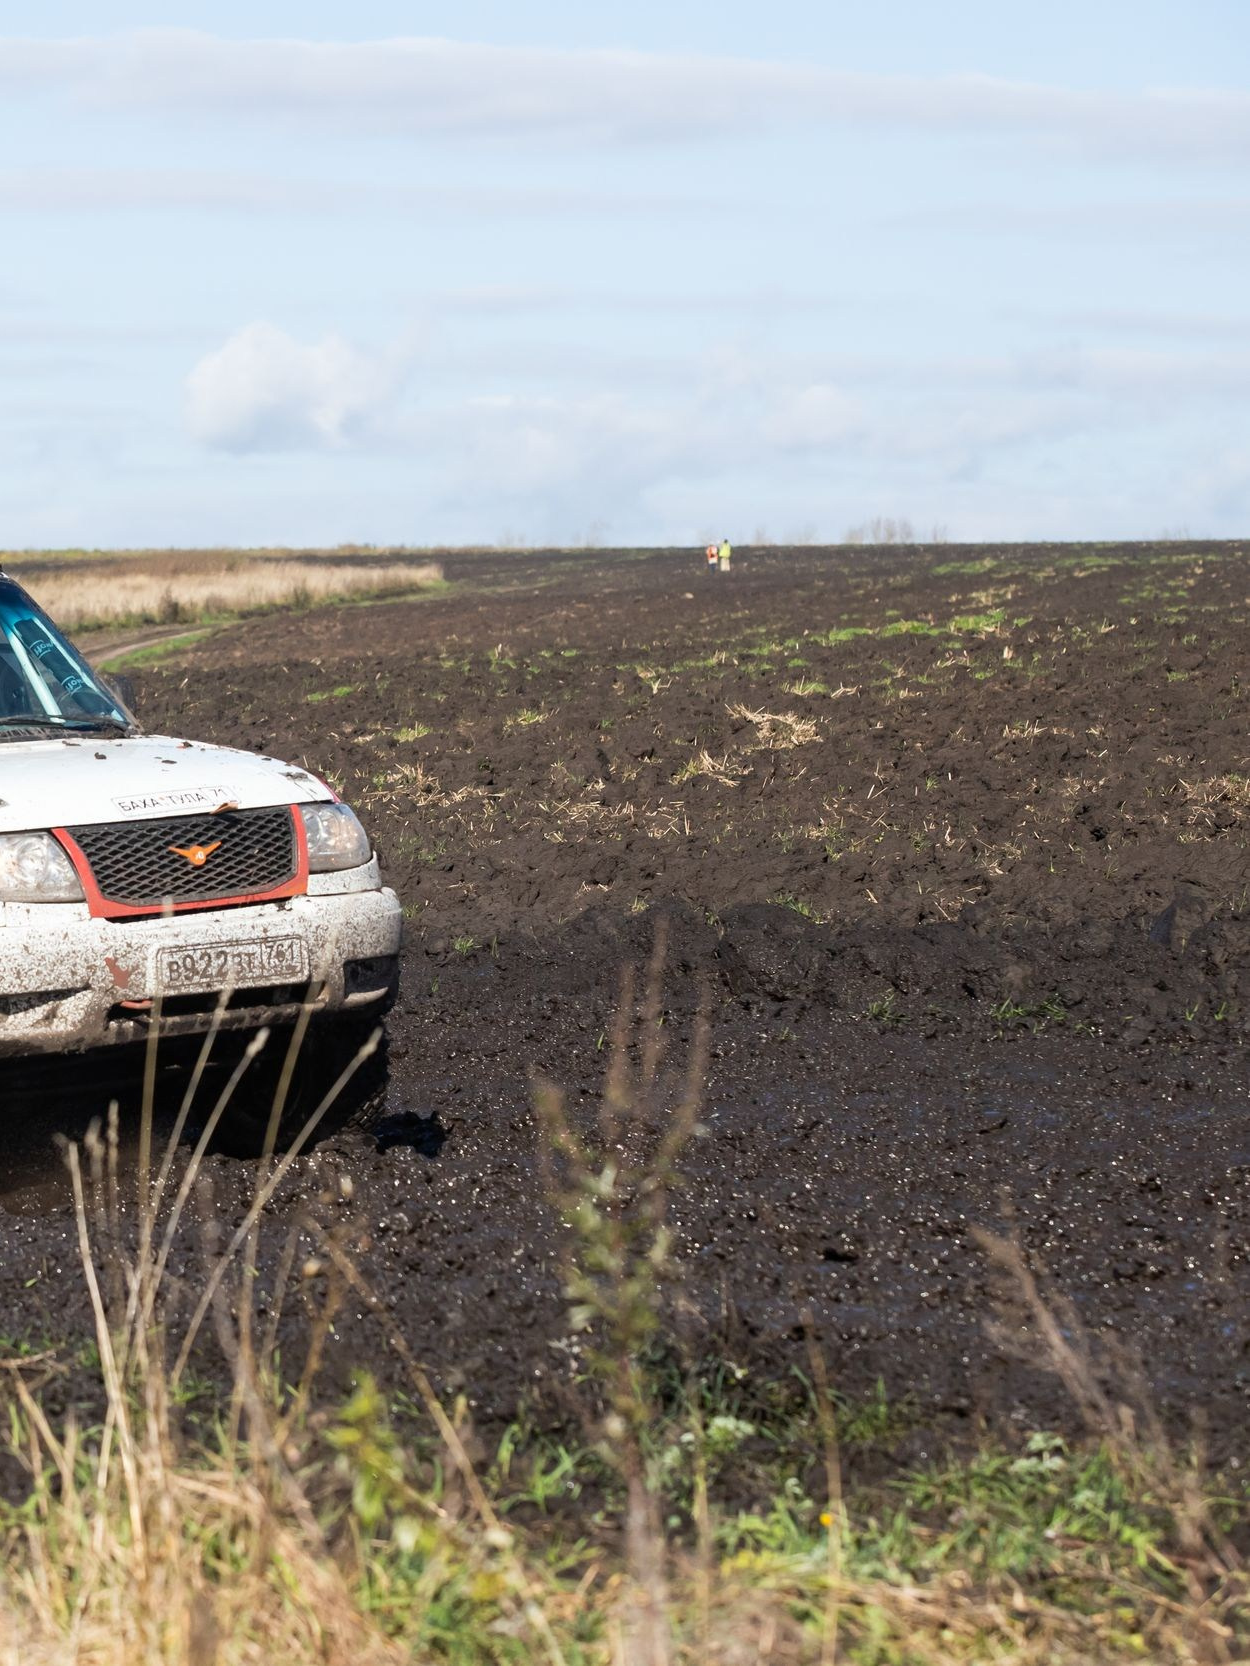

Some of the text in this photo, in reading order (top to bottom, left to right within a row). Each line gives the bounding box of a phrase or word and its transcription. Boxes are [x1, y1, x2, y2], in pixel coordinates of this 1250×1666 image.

[118, 798, 159, 812] БАХА
[213, 787, 227, 797] 71
[264, 941, 294, 965] 761
